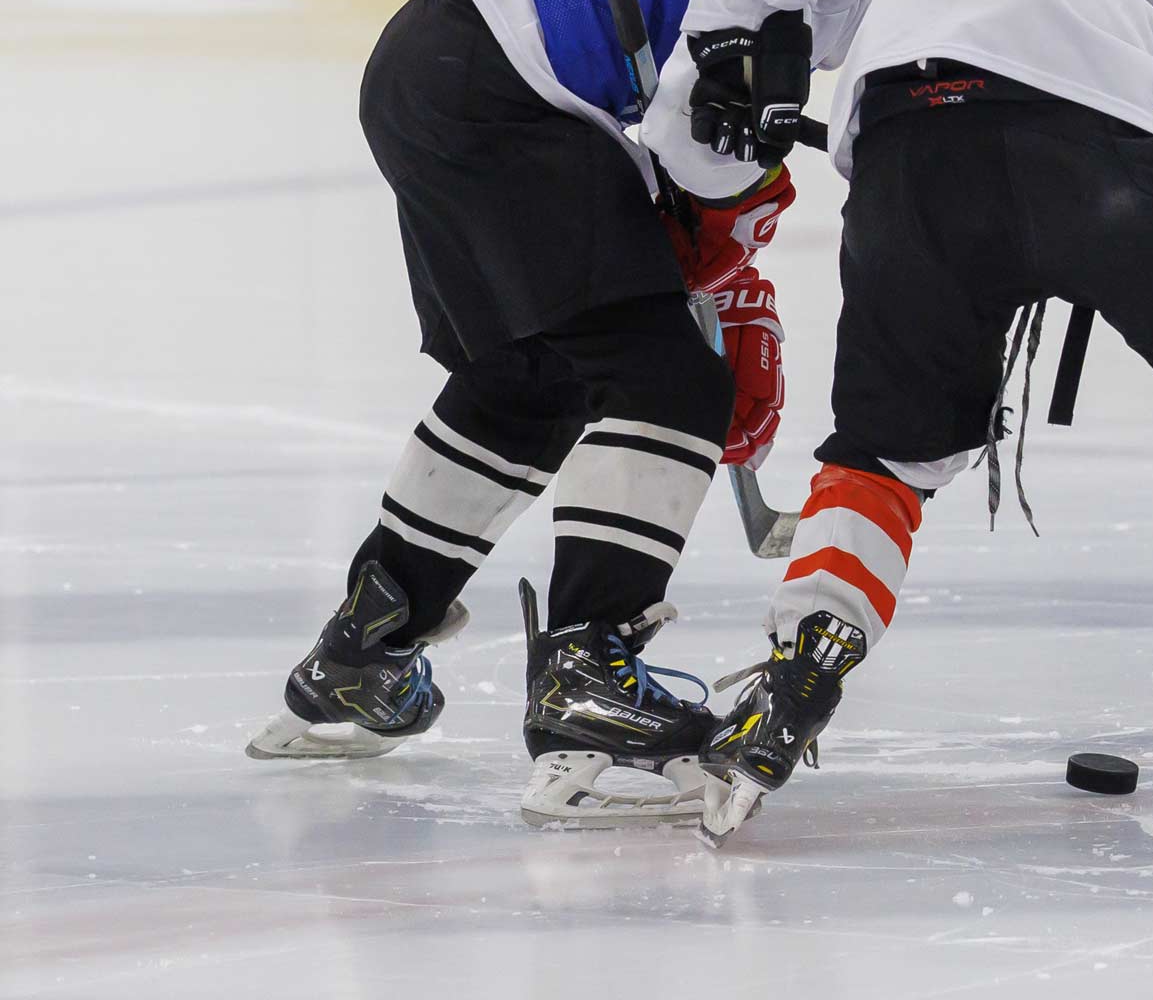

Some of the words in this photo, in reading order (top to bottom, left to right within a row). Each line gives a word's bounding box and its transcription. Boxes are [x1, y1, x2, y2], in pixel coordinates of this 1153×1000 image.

[711, 38, 739, 50] CCM
[908, 79, 986, 98] VAPOR
[611, 706, 663, 730] BAUER
